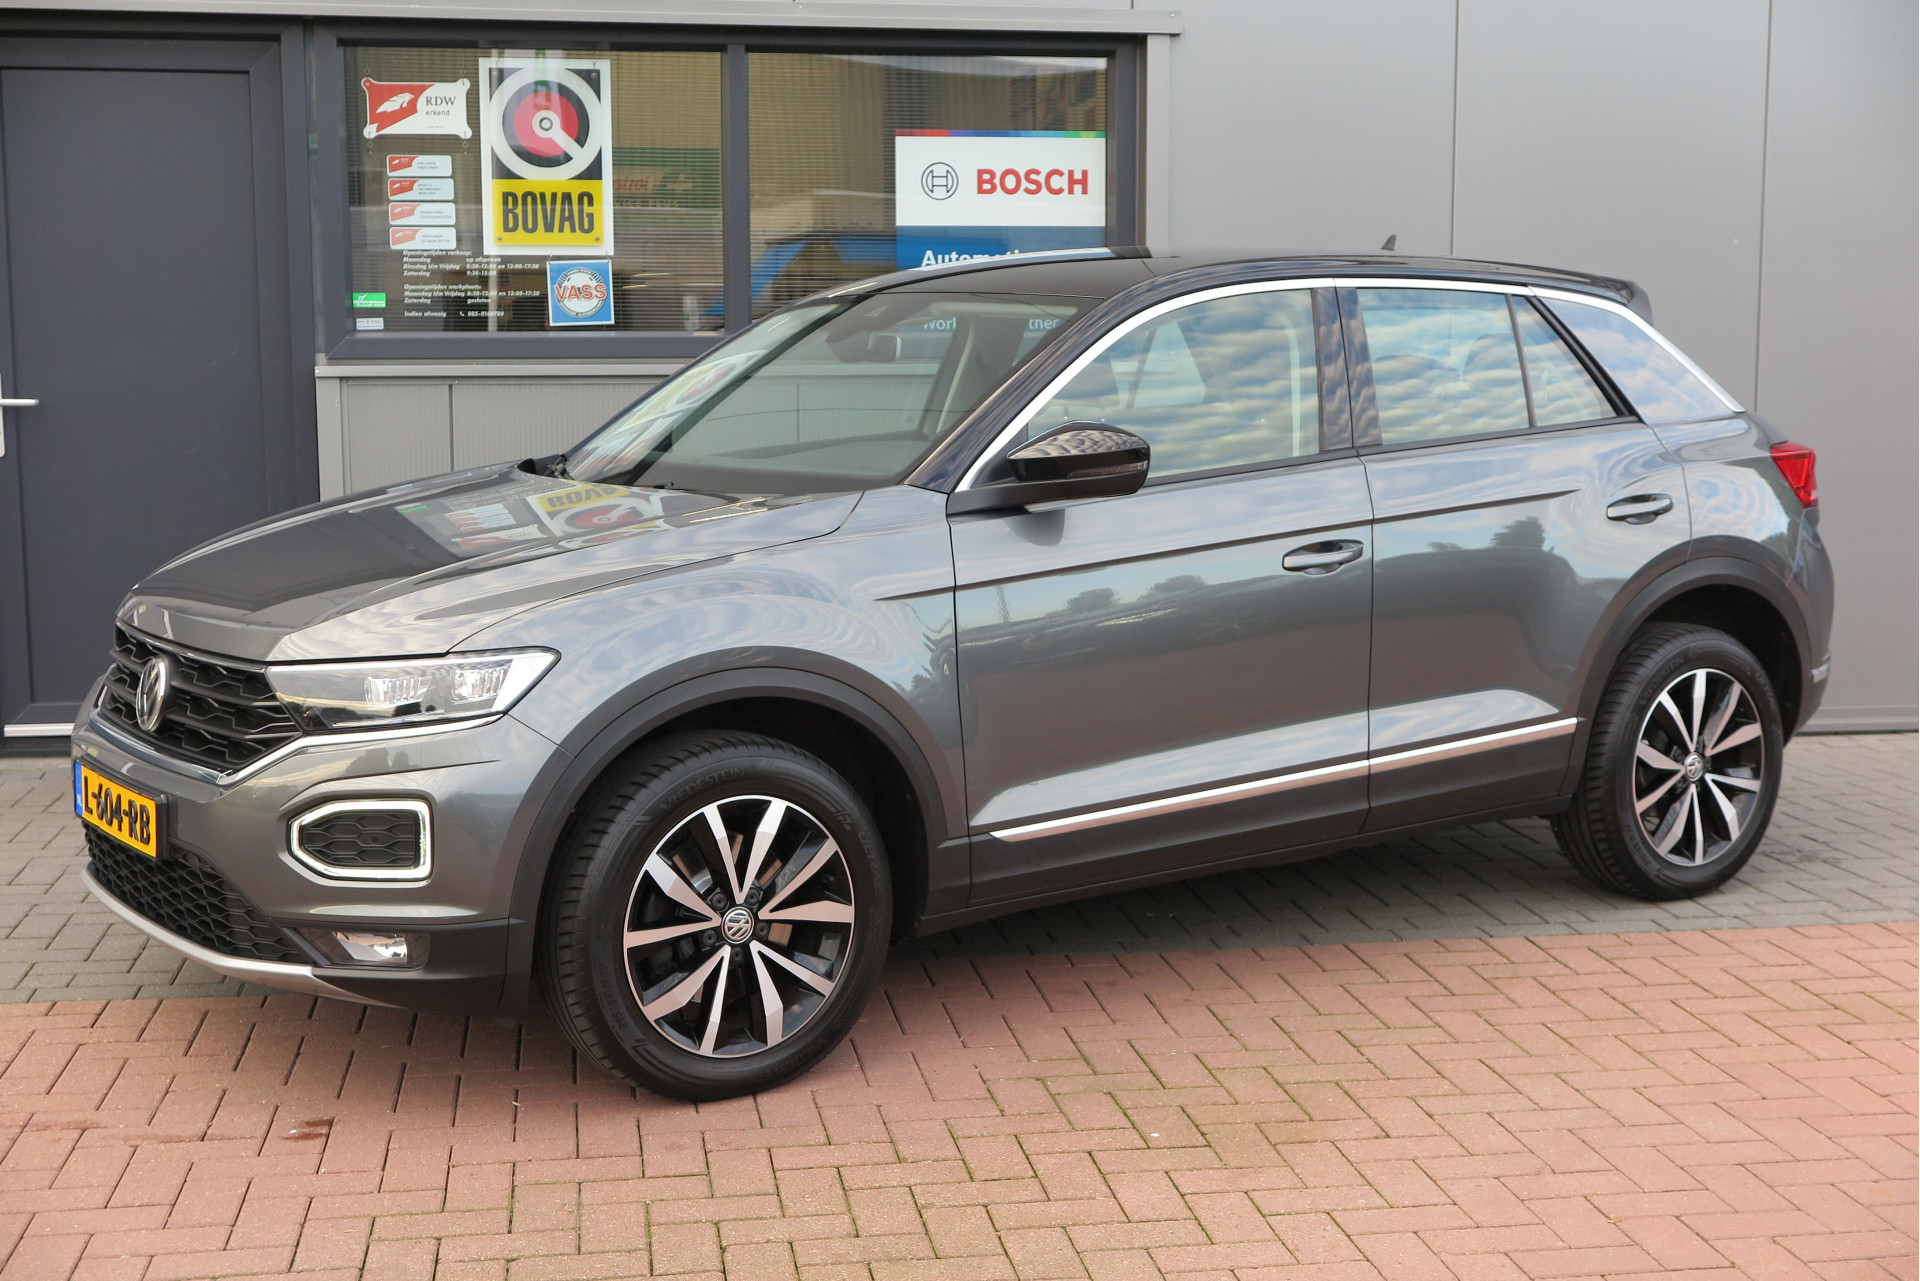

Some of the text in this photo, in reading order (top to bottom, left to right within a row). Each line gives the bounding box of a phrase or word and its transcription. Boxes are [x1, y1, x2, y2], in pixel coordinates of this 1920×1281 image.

[425, 96, 456, 106] RDW
[977, 168, 1088, 195] BOSCH
[502, 191, 595, 233] BOVAG
[554, 284, 607, 300] VASS
[84, 776, 150, 845] L-604-RB
